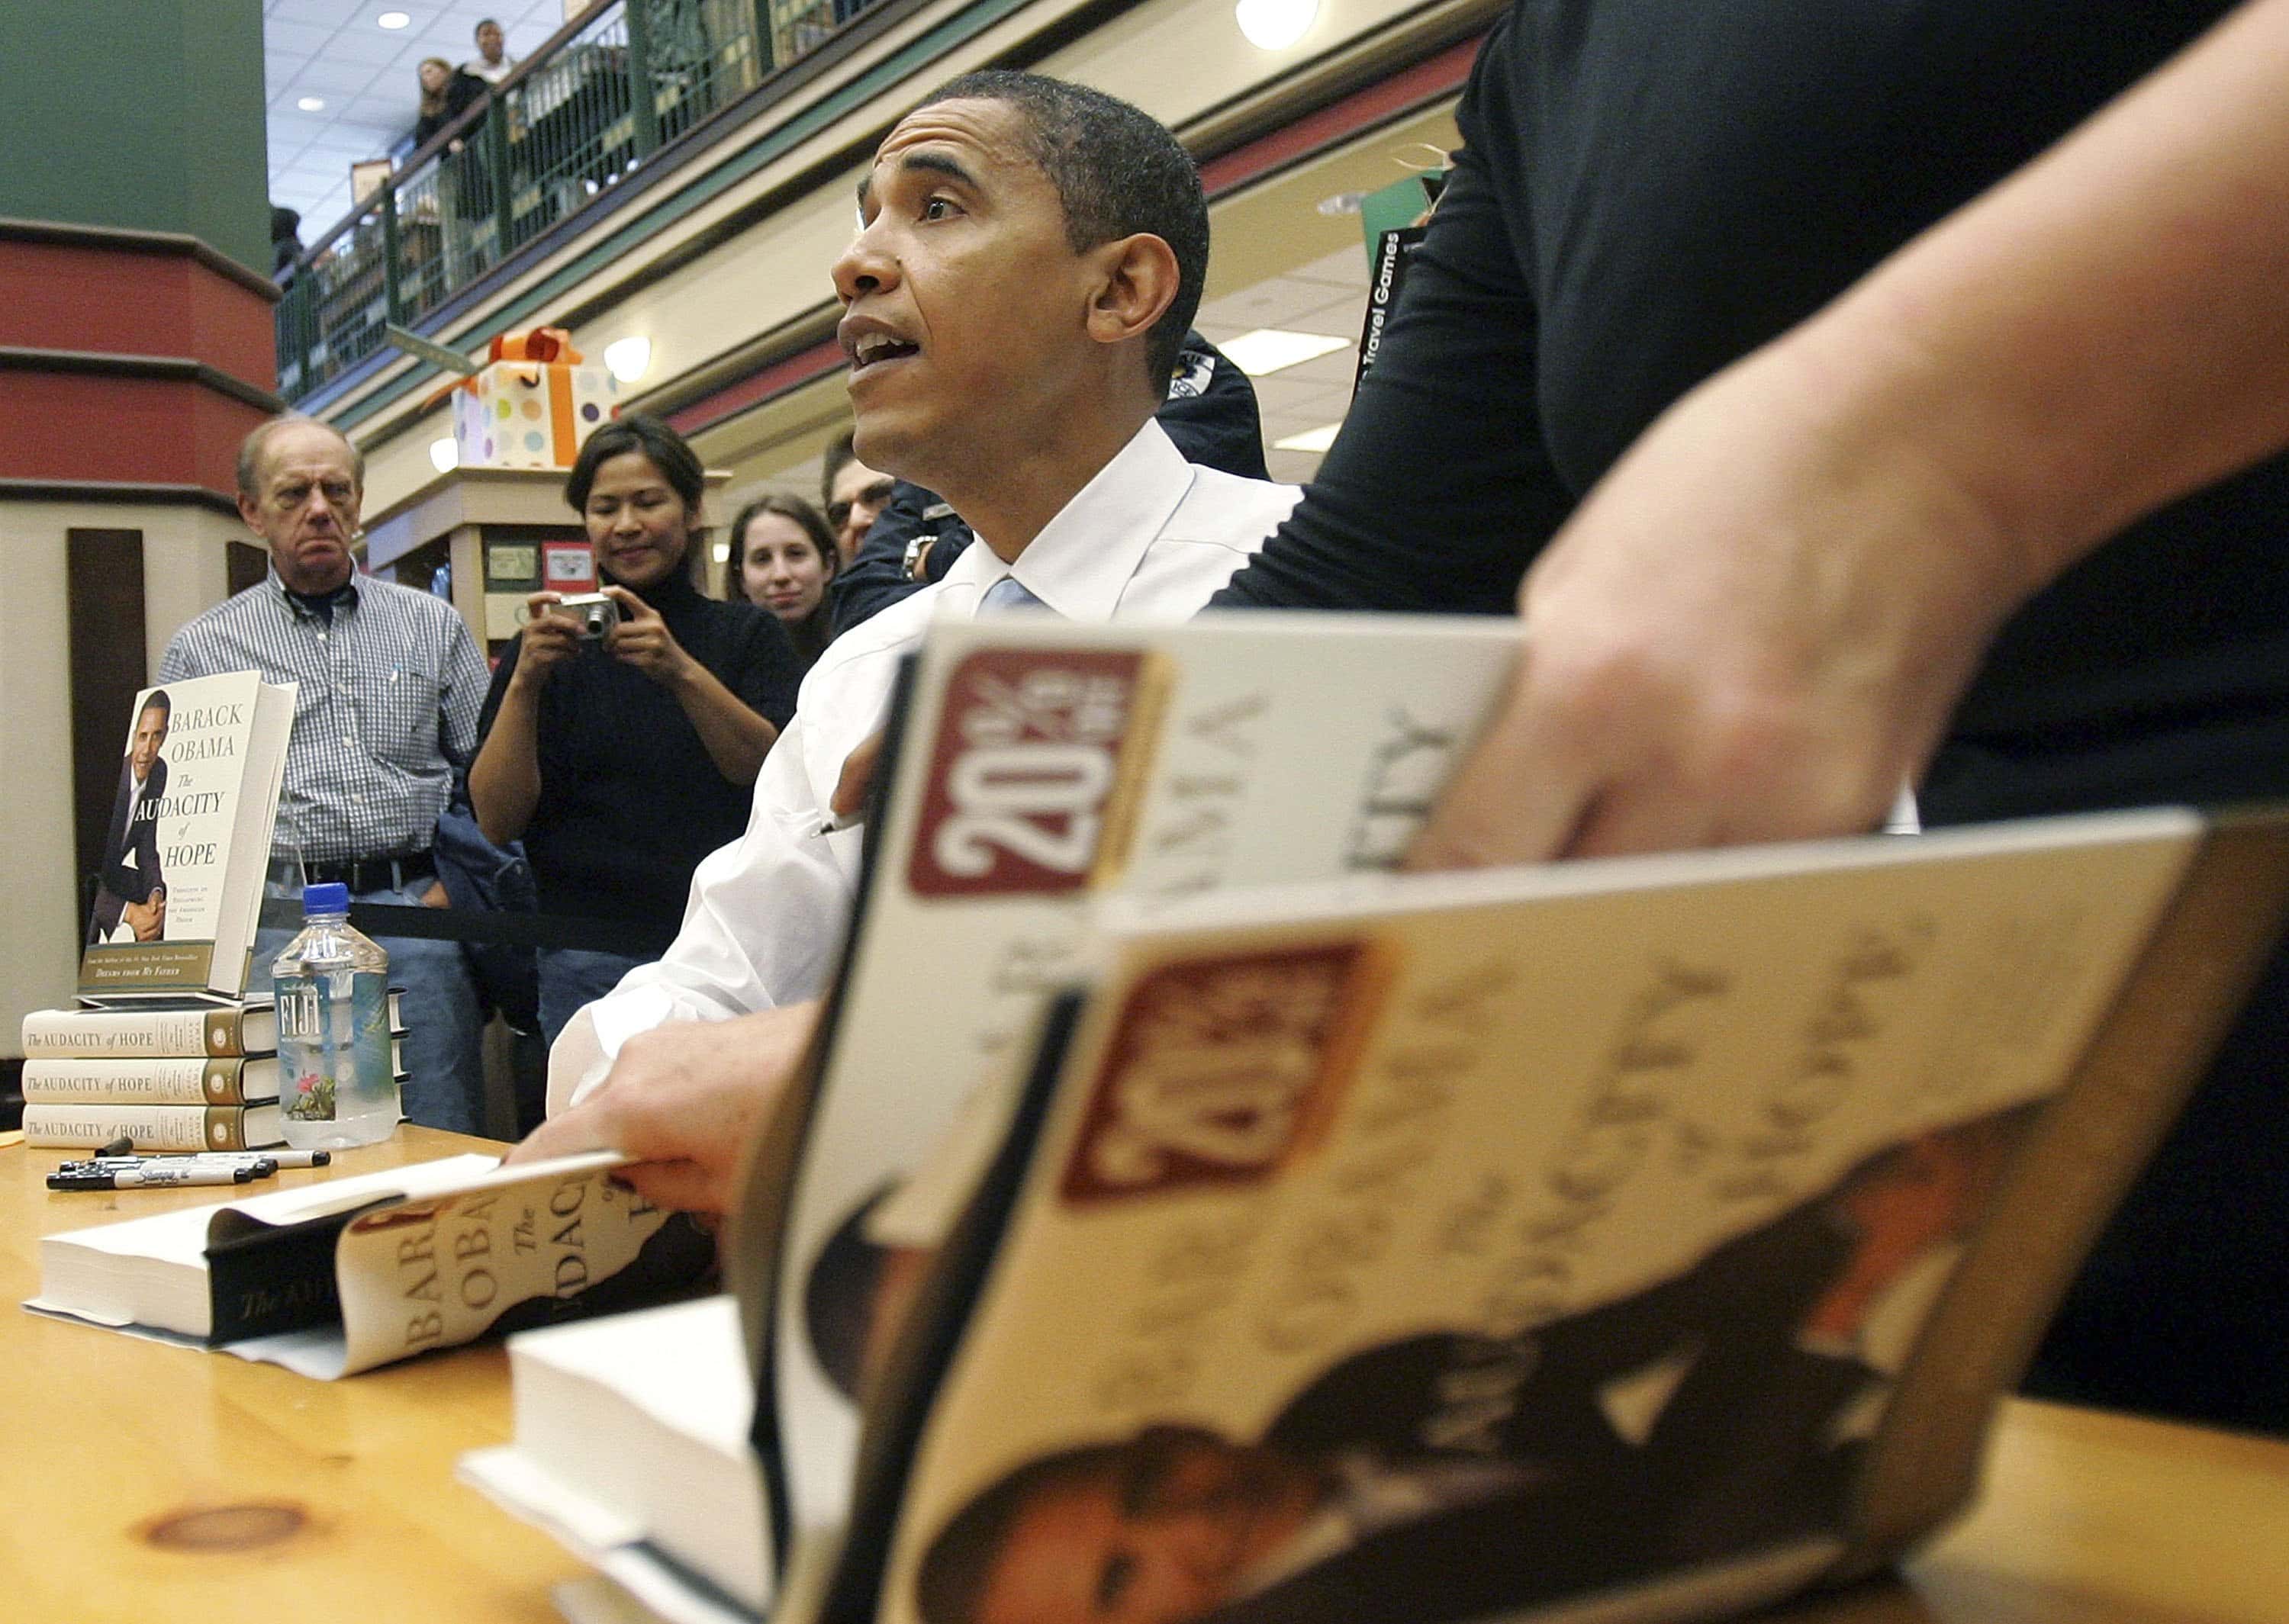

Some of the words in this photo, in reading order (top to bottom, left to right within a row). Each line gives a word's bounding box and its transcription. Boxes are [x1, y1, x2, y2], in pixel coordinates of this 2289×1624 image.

[1363, 309, 1386, 365] Travel
[1375, 233, 1399, 304] Games
[171, 703, 243, 733] BARACK
[172, 735, 235, 763] OBAMA
[178, 774, 193, 788] The
[134, 792, 225, 822] AUDACITY
[165, 843, 217, 867] HOPE
[280, 995, 320, 1035] FIJI
[27, 1034, 41, 1047] The
[44, 1033, 102, 1047] AUDACITY
[107, 1033, 117, 1050] of
[120, 1033, 153, 1046] HOPE
[27, 1078, 40, 1090] The
[43, 1077, 101, 1091] AUDACITY
[105, 1078, 115, 1095] of
[118, 1077, 152, 1091] HOPE
[28, 1122, 42, 1135] The
[44, 1123, 102, 1137] AUDACITY
[107, 1123, 116, 1140] of
[121, 1124, 154, 1138] HOPE
[513, 1208, 536, 1256] The
